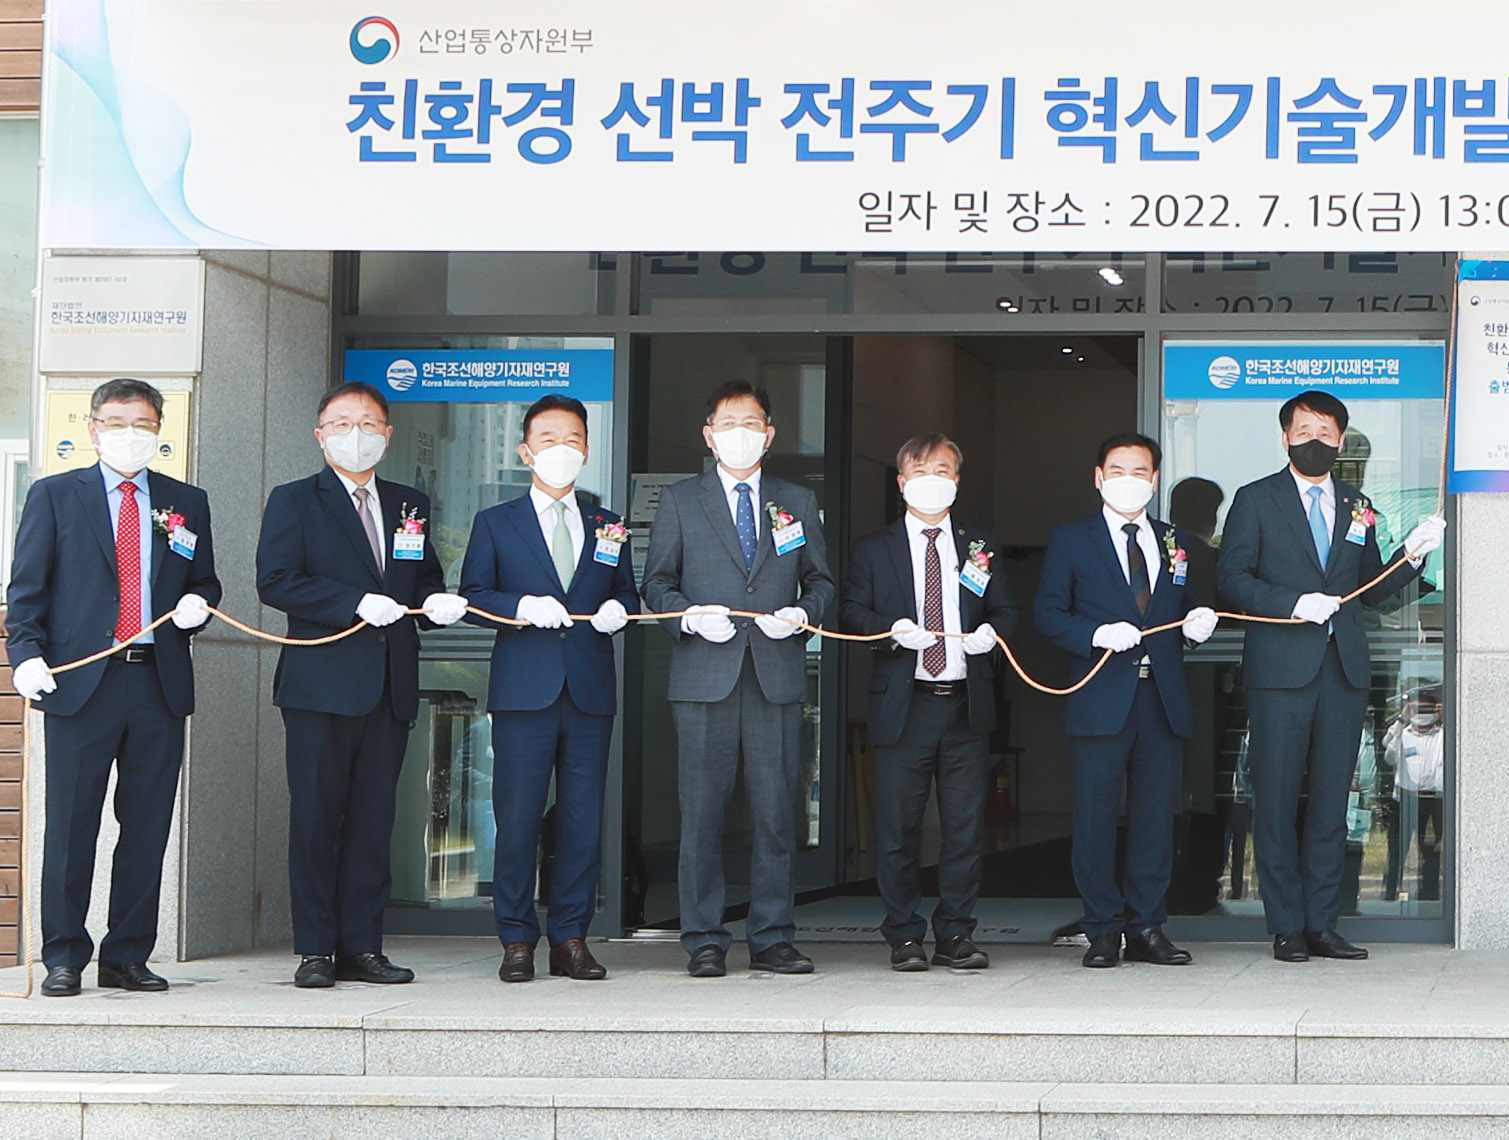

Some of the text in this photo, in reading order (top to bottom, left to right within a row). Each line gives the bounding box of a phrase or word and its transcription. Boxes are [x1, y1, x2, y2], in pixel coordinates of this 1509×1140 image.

[419, 29, 593, 54] 산업통상자원부
[346, 78, 575, 164] 친환경
[600, 78, 761, 164] 선박
[780, 77, 1015, 162] 전주기
[859, 191, 937, 233] 일자
[954, 191, 988, 233] 및
[1006, 191, 1086, 233] 장소
[1130, 195, 1240, 227] 2022.
[1259, 195, 1289, 227] 7.
[1309, 192, 1420, 232] 15(금)
[51, 311, 187, 325] 한국조선해양기자재연구원
[422, 362, 570, 378] 한국조선해양기자재연구원
[1245, 359, 1400, 376] 한국조선해양기자재연구원
[469, 380, 505, 389] Equipment
[1246, 377, 1400, 387] Korea Marine Equipment Research Institute
